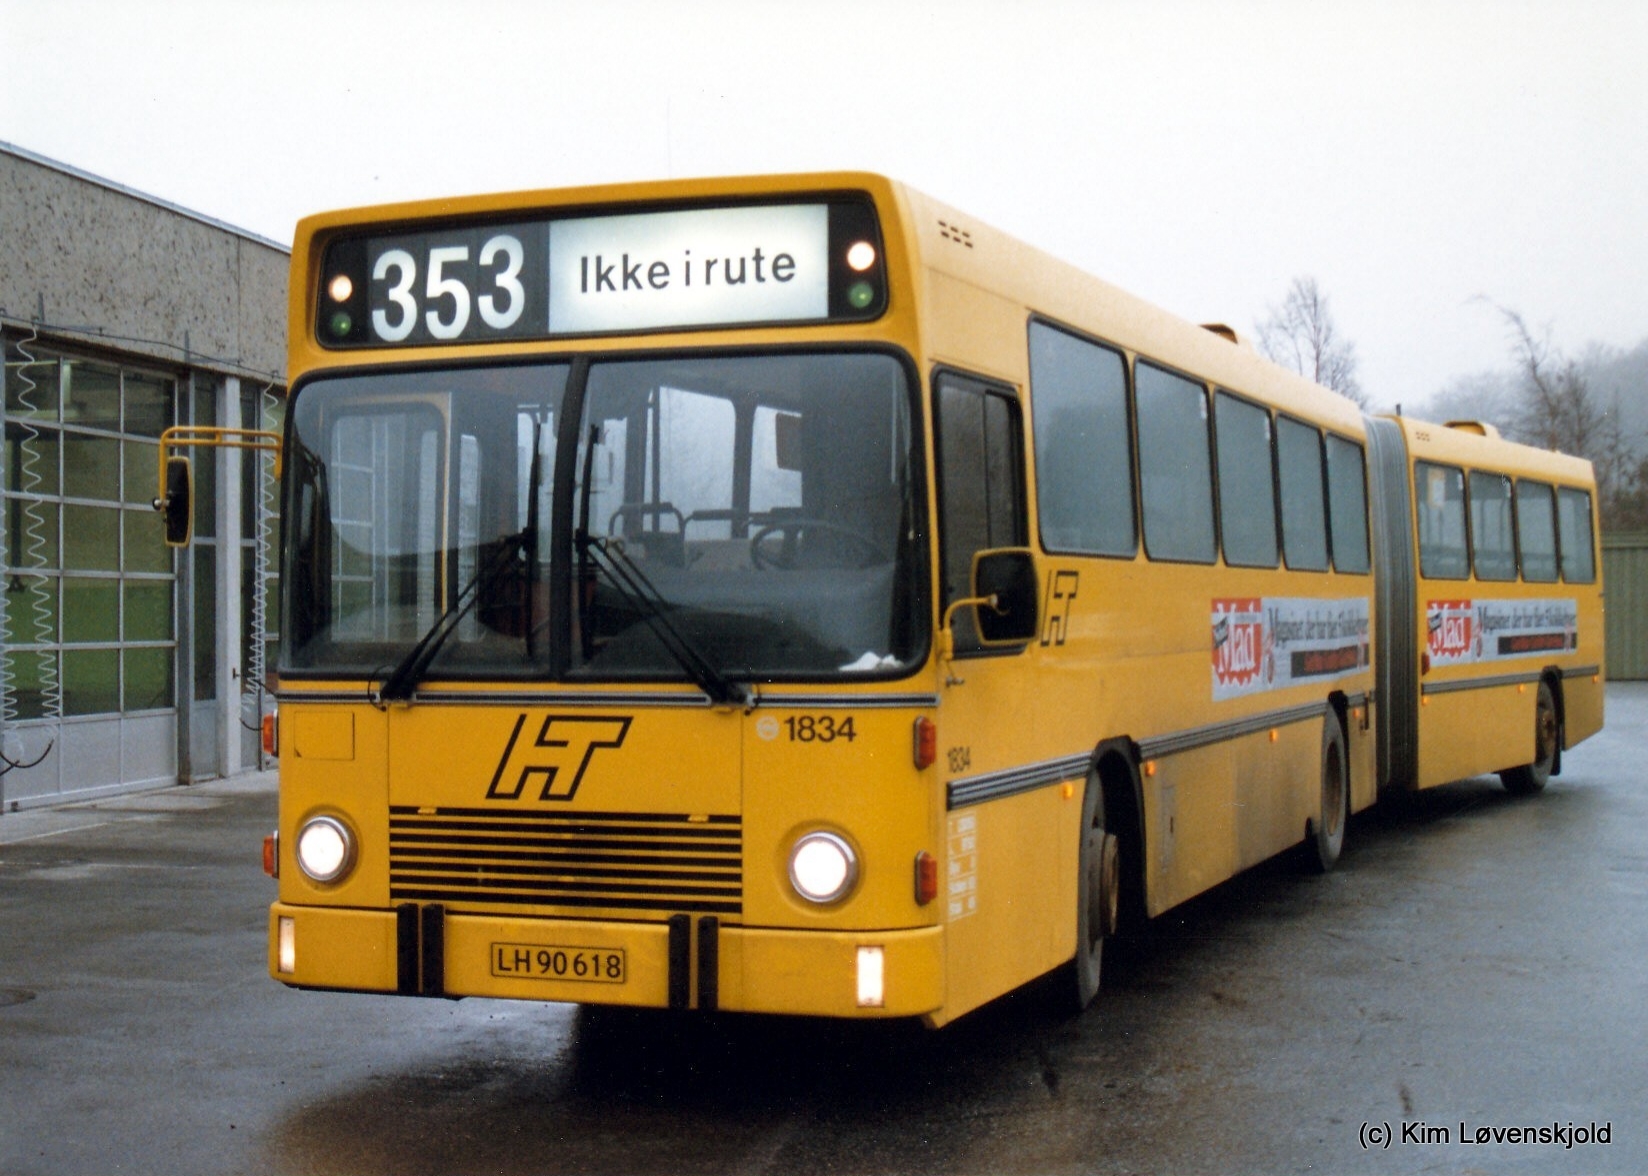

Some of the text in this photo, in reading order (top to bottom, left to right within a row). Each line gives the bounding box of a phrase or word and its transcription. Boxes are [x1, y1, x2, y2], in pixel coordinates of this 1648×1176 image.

[371, 234, 526, 342] 353
[580, 246, 797, 294] Ikke i rute
[783, 715, 857, 743] 1834
[485, 713, 634, 802] HT
[947, 746, 971, 773] 1834
